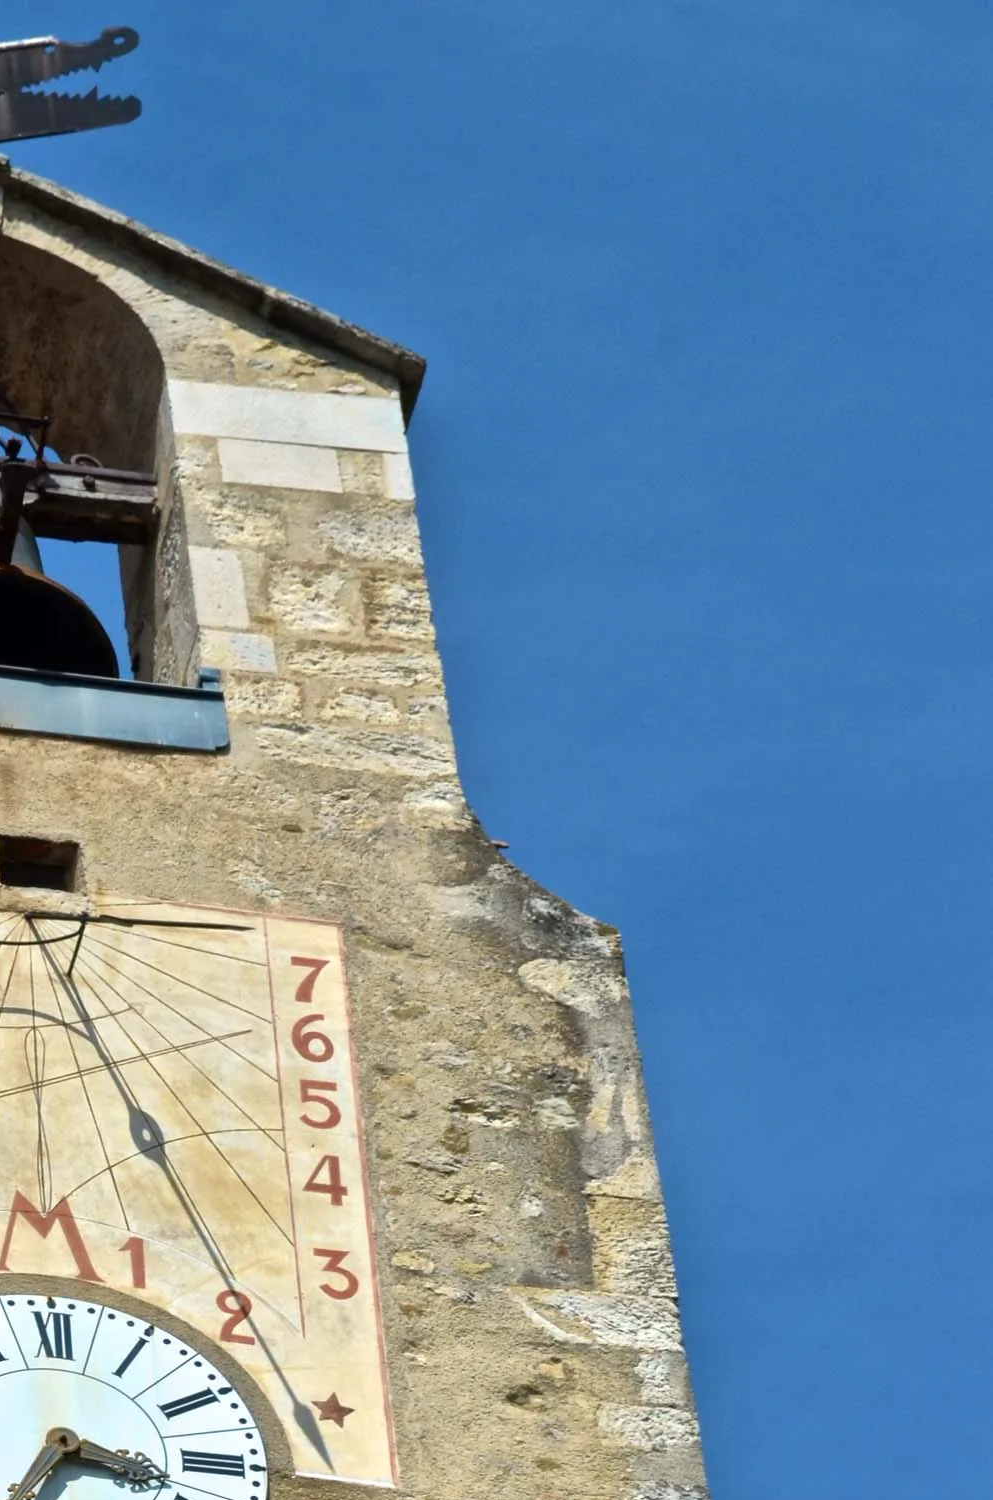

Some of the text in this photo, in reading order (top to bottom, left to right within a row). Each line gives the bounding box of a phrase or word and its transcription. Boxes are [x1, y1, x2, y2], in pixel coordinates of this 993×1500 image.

[290, 956, 330, 1002] 7
[291, 1014, 334, 1063] 6
[300, 1079, 342, 1130] 5
[305, 1155, 347, 1207] 4
[119, 1236, 146, 1289] 1
[313, 1248, 359, 1300] 3
[31, 1310, 75, 1361] XII
[215, 1290, 256, 1346] 2
[112, 1336, 150, 1379] I
[157, 1387, 221, 1421] II
[180, 1448, 246, 1479] III
